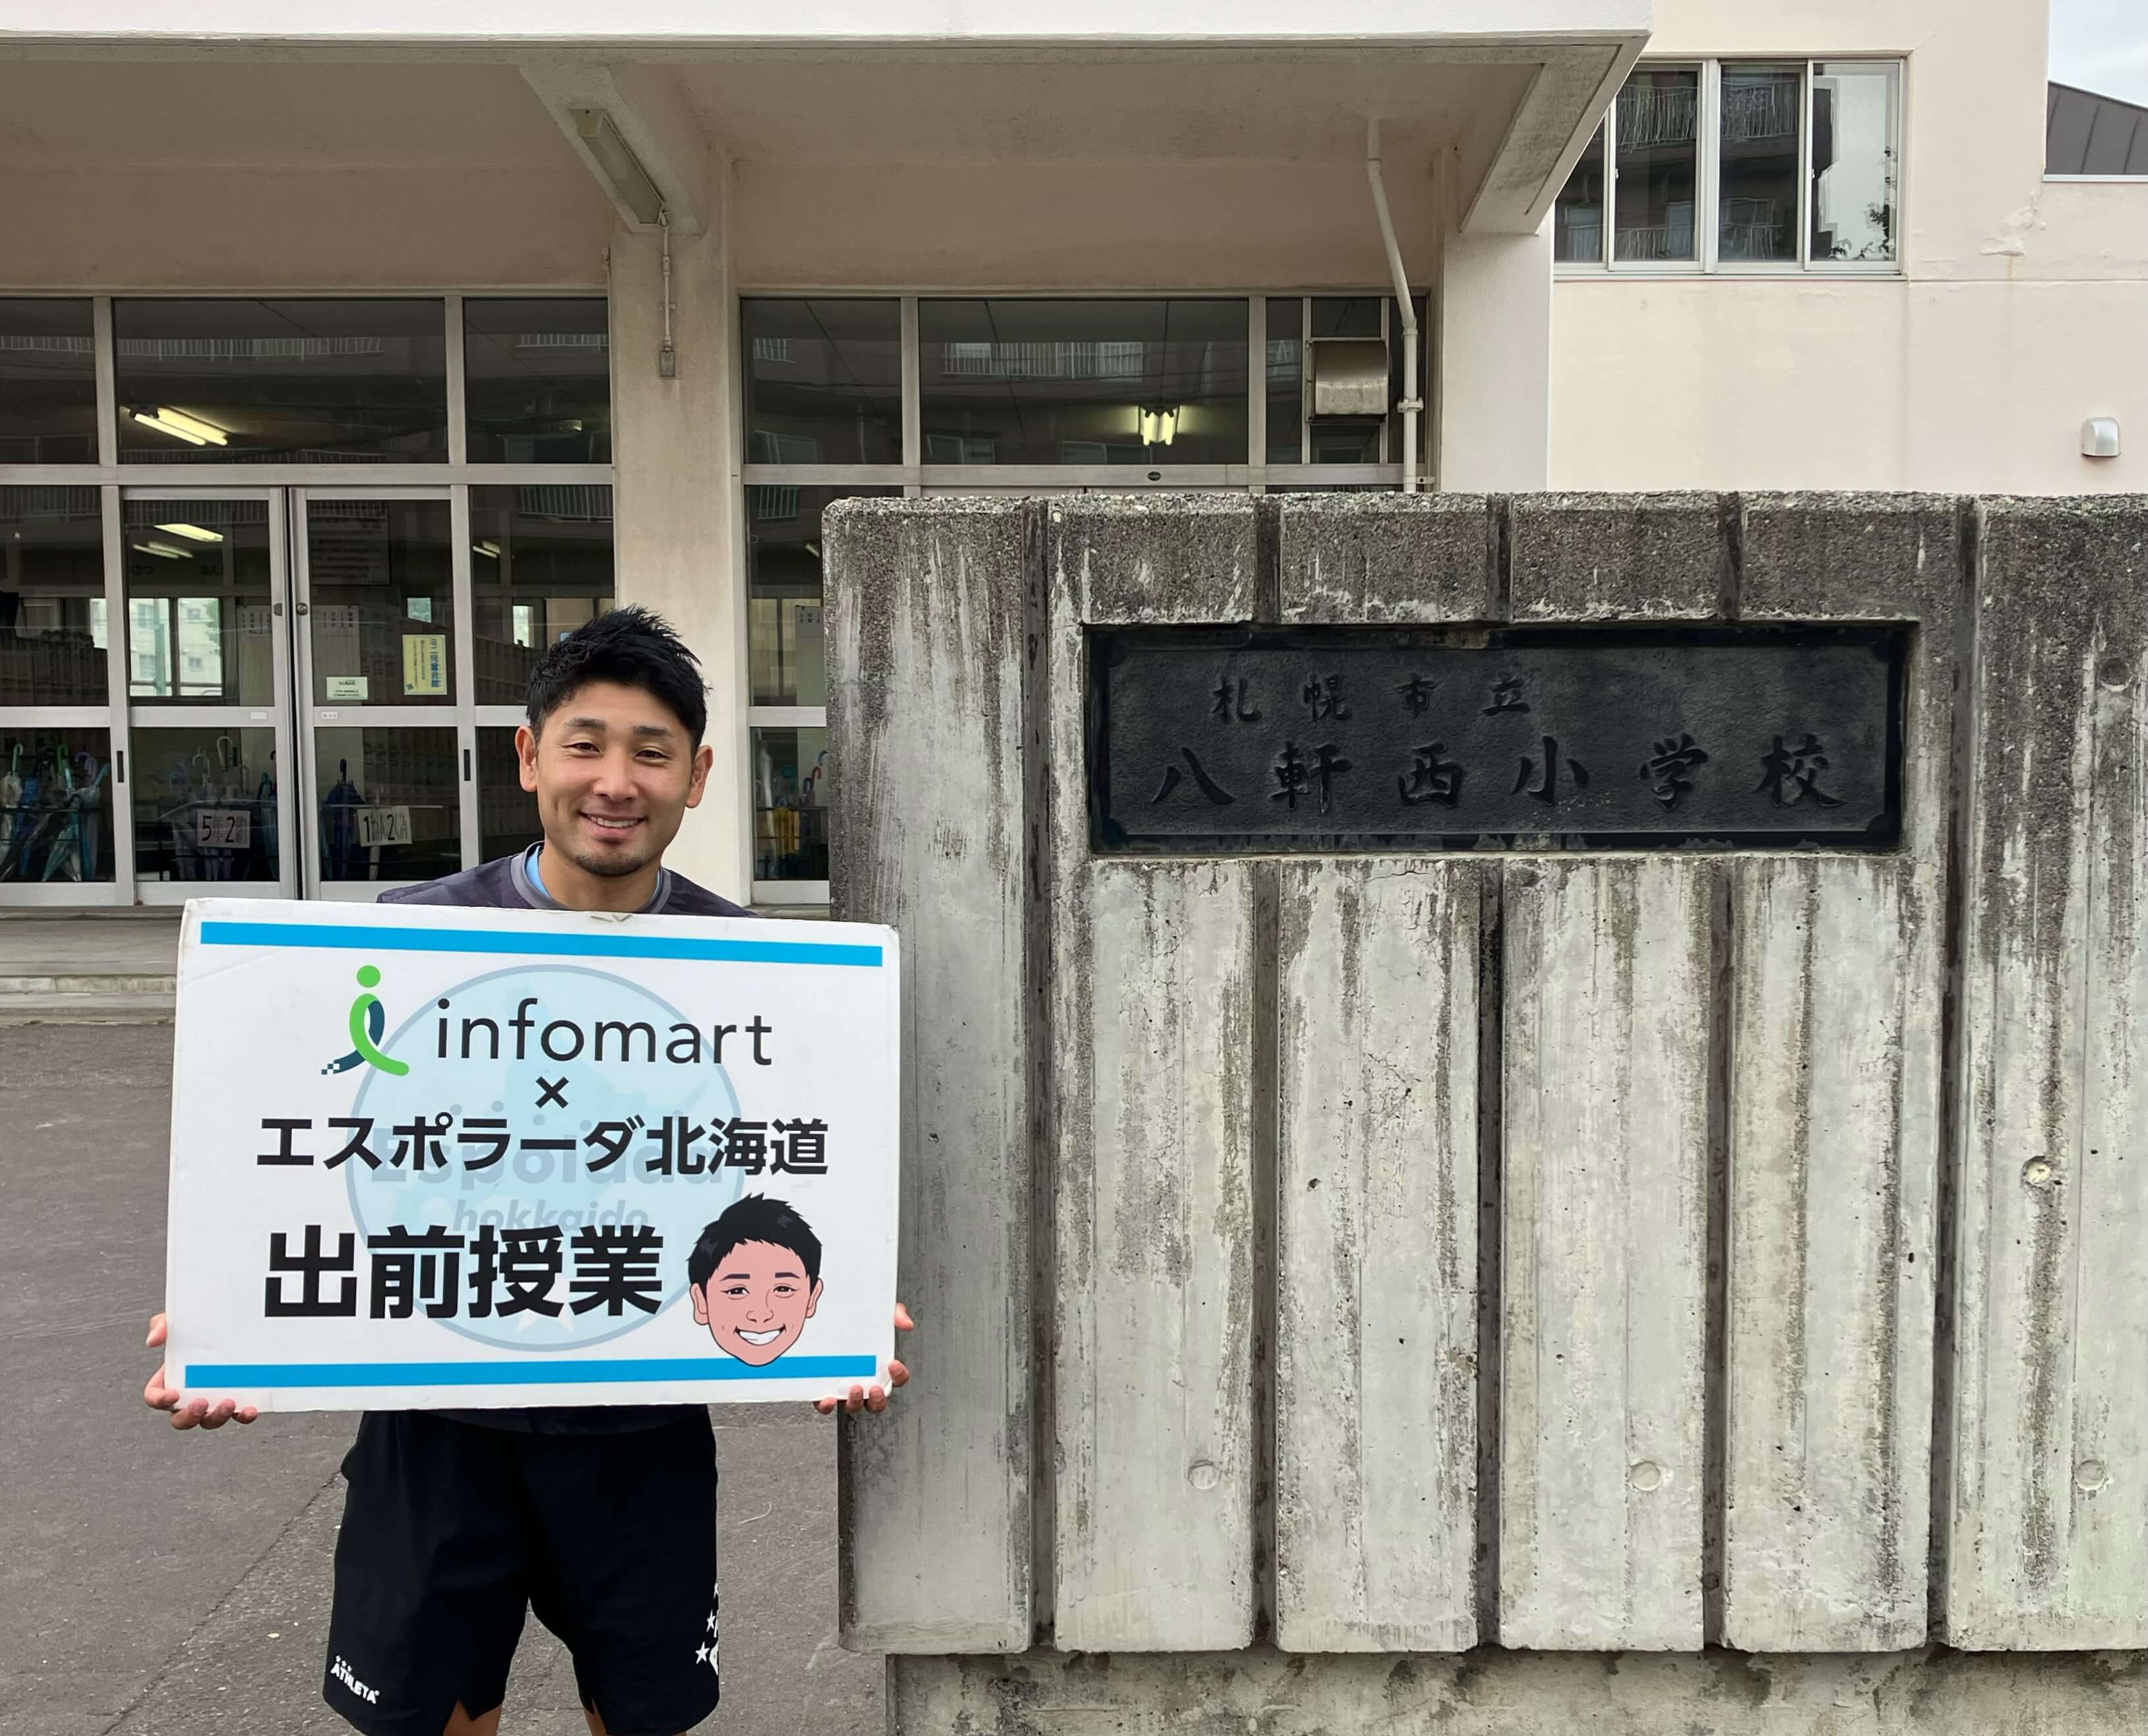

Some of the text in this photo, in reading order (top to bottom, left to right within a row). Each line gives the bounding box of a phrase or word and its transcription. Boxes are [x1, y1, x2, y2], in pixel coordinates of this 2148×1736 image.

[1210, 673, 1531, 724] 札幌市立
[1151, 733, 1845, 813] 八軒西小学校
[438, 997, 773, 1066] infomart
[257, 1111, 828, 1176] エスポラーダ北海道
[264, 1224, 664, 1320] 出前授業
[330, 1662, 377, 1704] ATHLETA
